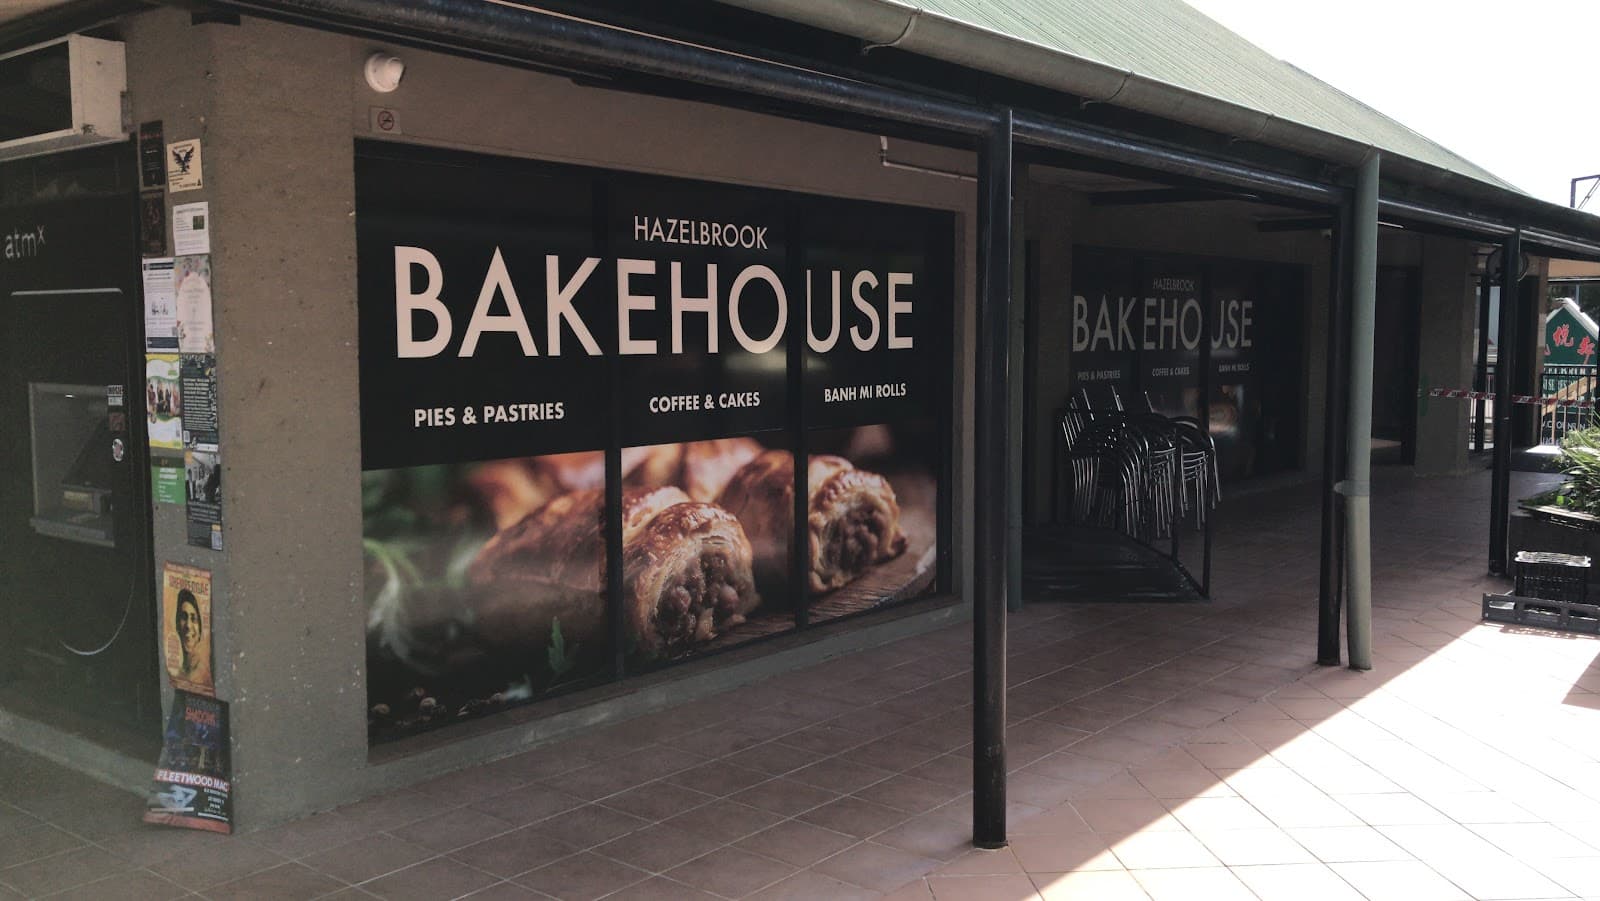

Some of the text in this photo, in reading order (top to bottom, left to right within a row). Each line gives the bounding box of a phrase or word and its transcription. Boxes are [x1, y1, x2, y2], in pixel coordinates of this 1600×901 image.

[634, 215, 768, 250] HAZELBROOK
[394, 245, 914, 359] BAKEHOUSE
[649, 392, 761, 413] COFFEE & CAKES
[824, 383, 907, 402] BANH MI ROLLS
[414, 402, 565, 427] PIES & PASTRIES
[157, 769, 213, 787] FLEETWOOD
